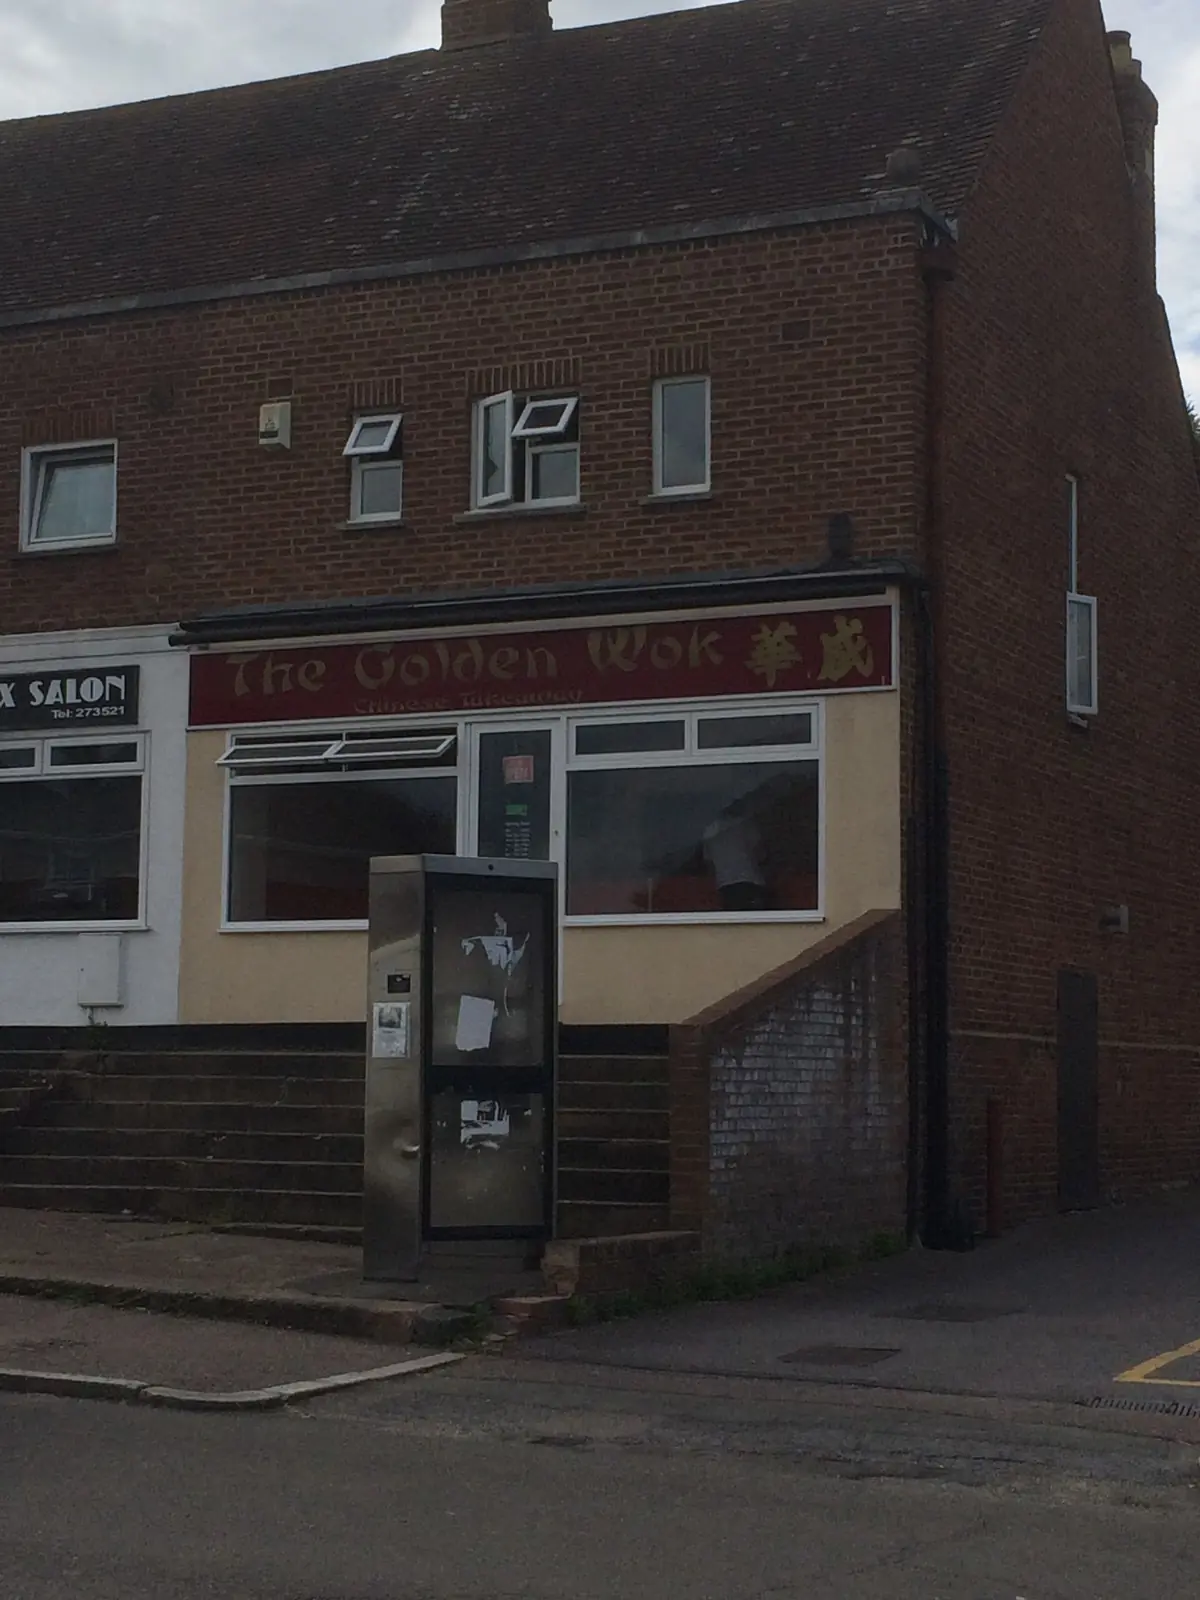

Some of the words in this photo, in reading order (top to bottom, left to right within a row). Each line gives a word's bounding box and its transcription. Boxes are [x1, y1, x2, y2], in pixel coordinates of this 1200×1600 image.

[225, 651, 326, 696] The
[354, 638, 558, 690] Golden
[587, 624, 724, 672] Wok
[29, 674, 126, 706] SALON
[51, 709, 73, 719] Tel:
[75, 705, 125, 718] 273521
